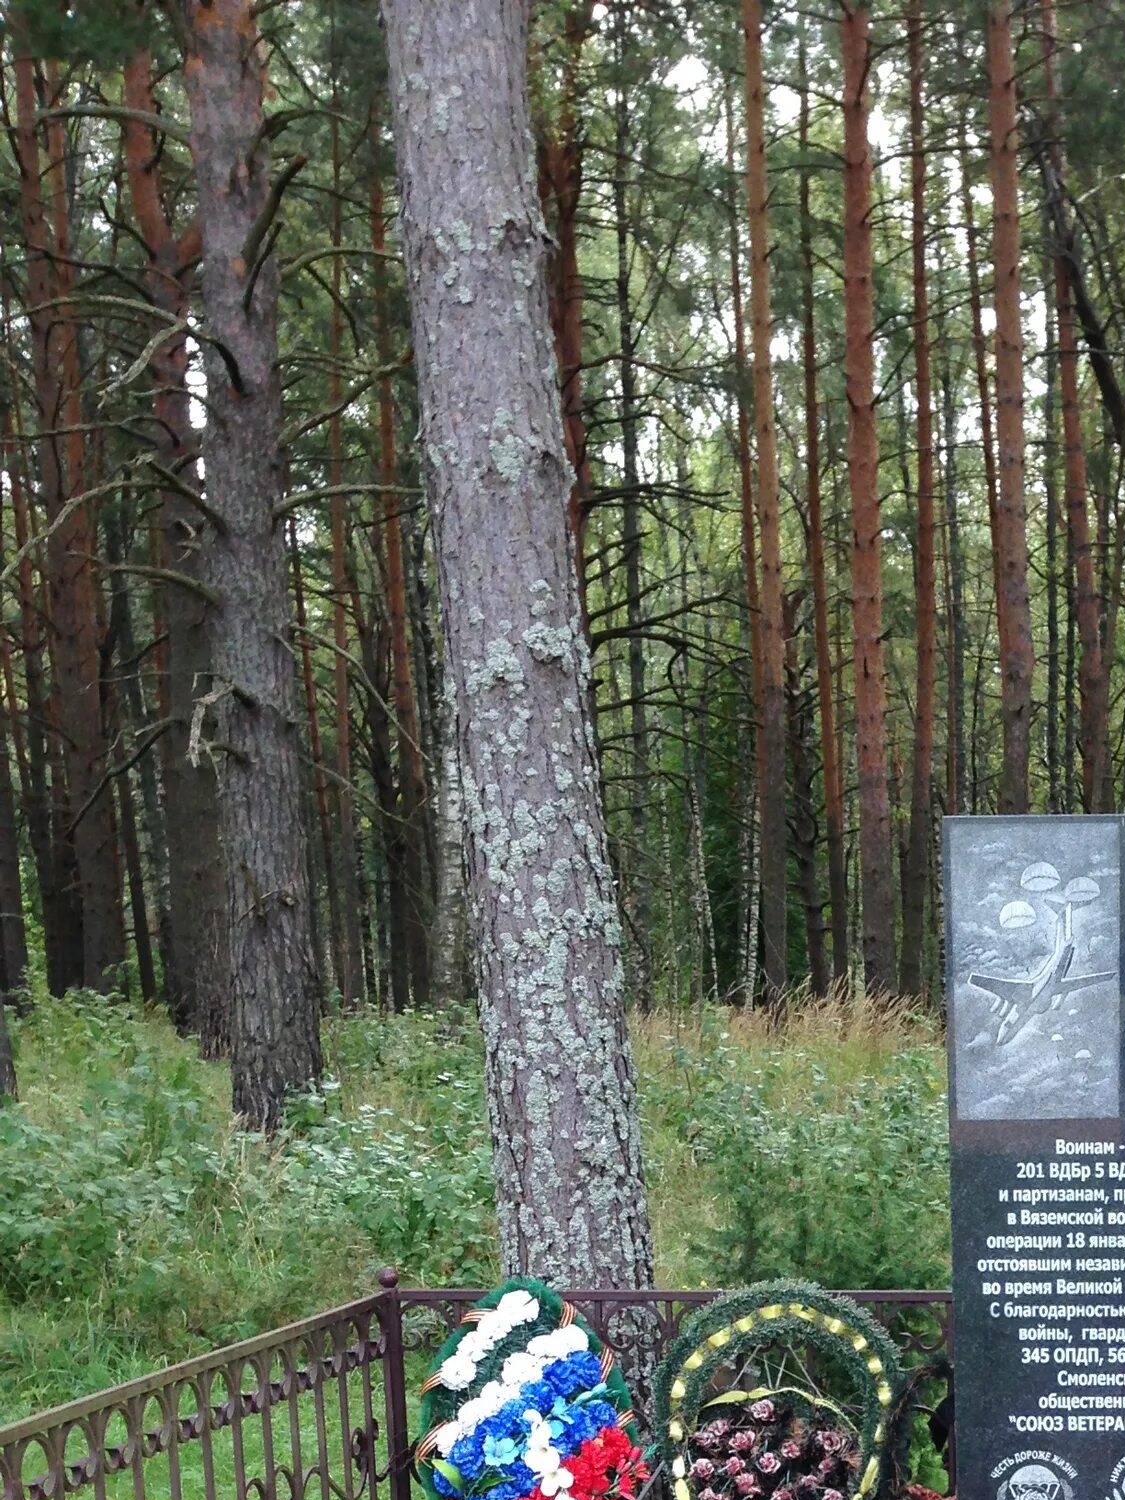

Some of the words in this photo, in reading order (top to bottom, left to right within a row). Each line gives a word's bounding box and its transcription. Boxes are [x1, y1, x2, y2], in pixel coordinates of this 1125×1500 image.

[1055, 1138, 1115, 1155] Воинам
[1016, 1162, 1045, 1179] 201
[1049, 1162, 1091, 1182] ВДБр
[1094, 1162, 1105, 1179] 5
[998, 1189, 1009, 1202] и
[1012, 1188, 1110, 1206] партизанам,
[1007, 1212, 1017, 1225] в
[1020, 1207, 1104, 1226] Вяземской
[986, 1235, 1062, 1253] операции
[1066, 1231, 1086, 1249] 18
[977, 1258, 1072, 1272] отстоявшим
[982, 1281, 1002, 1295] во
[1004, 1281, 1052, 1299] время
[1056, 1277, 1123, 1295] Великой
[989, 1301, 1001, 1318] С
[1018, 1323, 1073, 1344] войны,
[1021, 1347, 1050, 1364] 345
[1053, 1347, 1104, 1367] ОПДП,
[990, 1456, 1016, 1479] ЧЕСТЬ
[1014, 1449, 1052, 1464] ДОРОЖЕ
[1051, 1455, 1079, 1479] ЖИЗНИ
